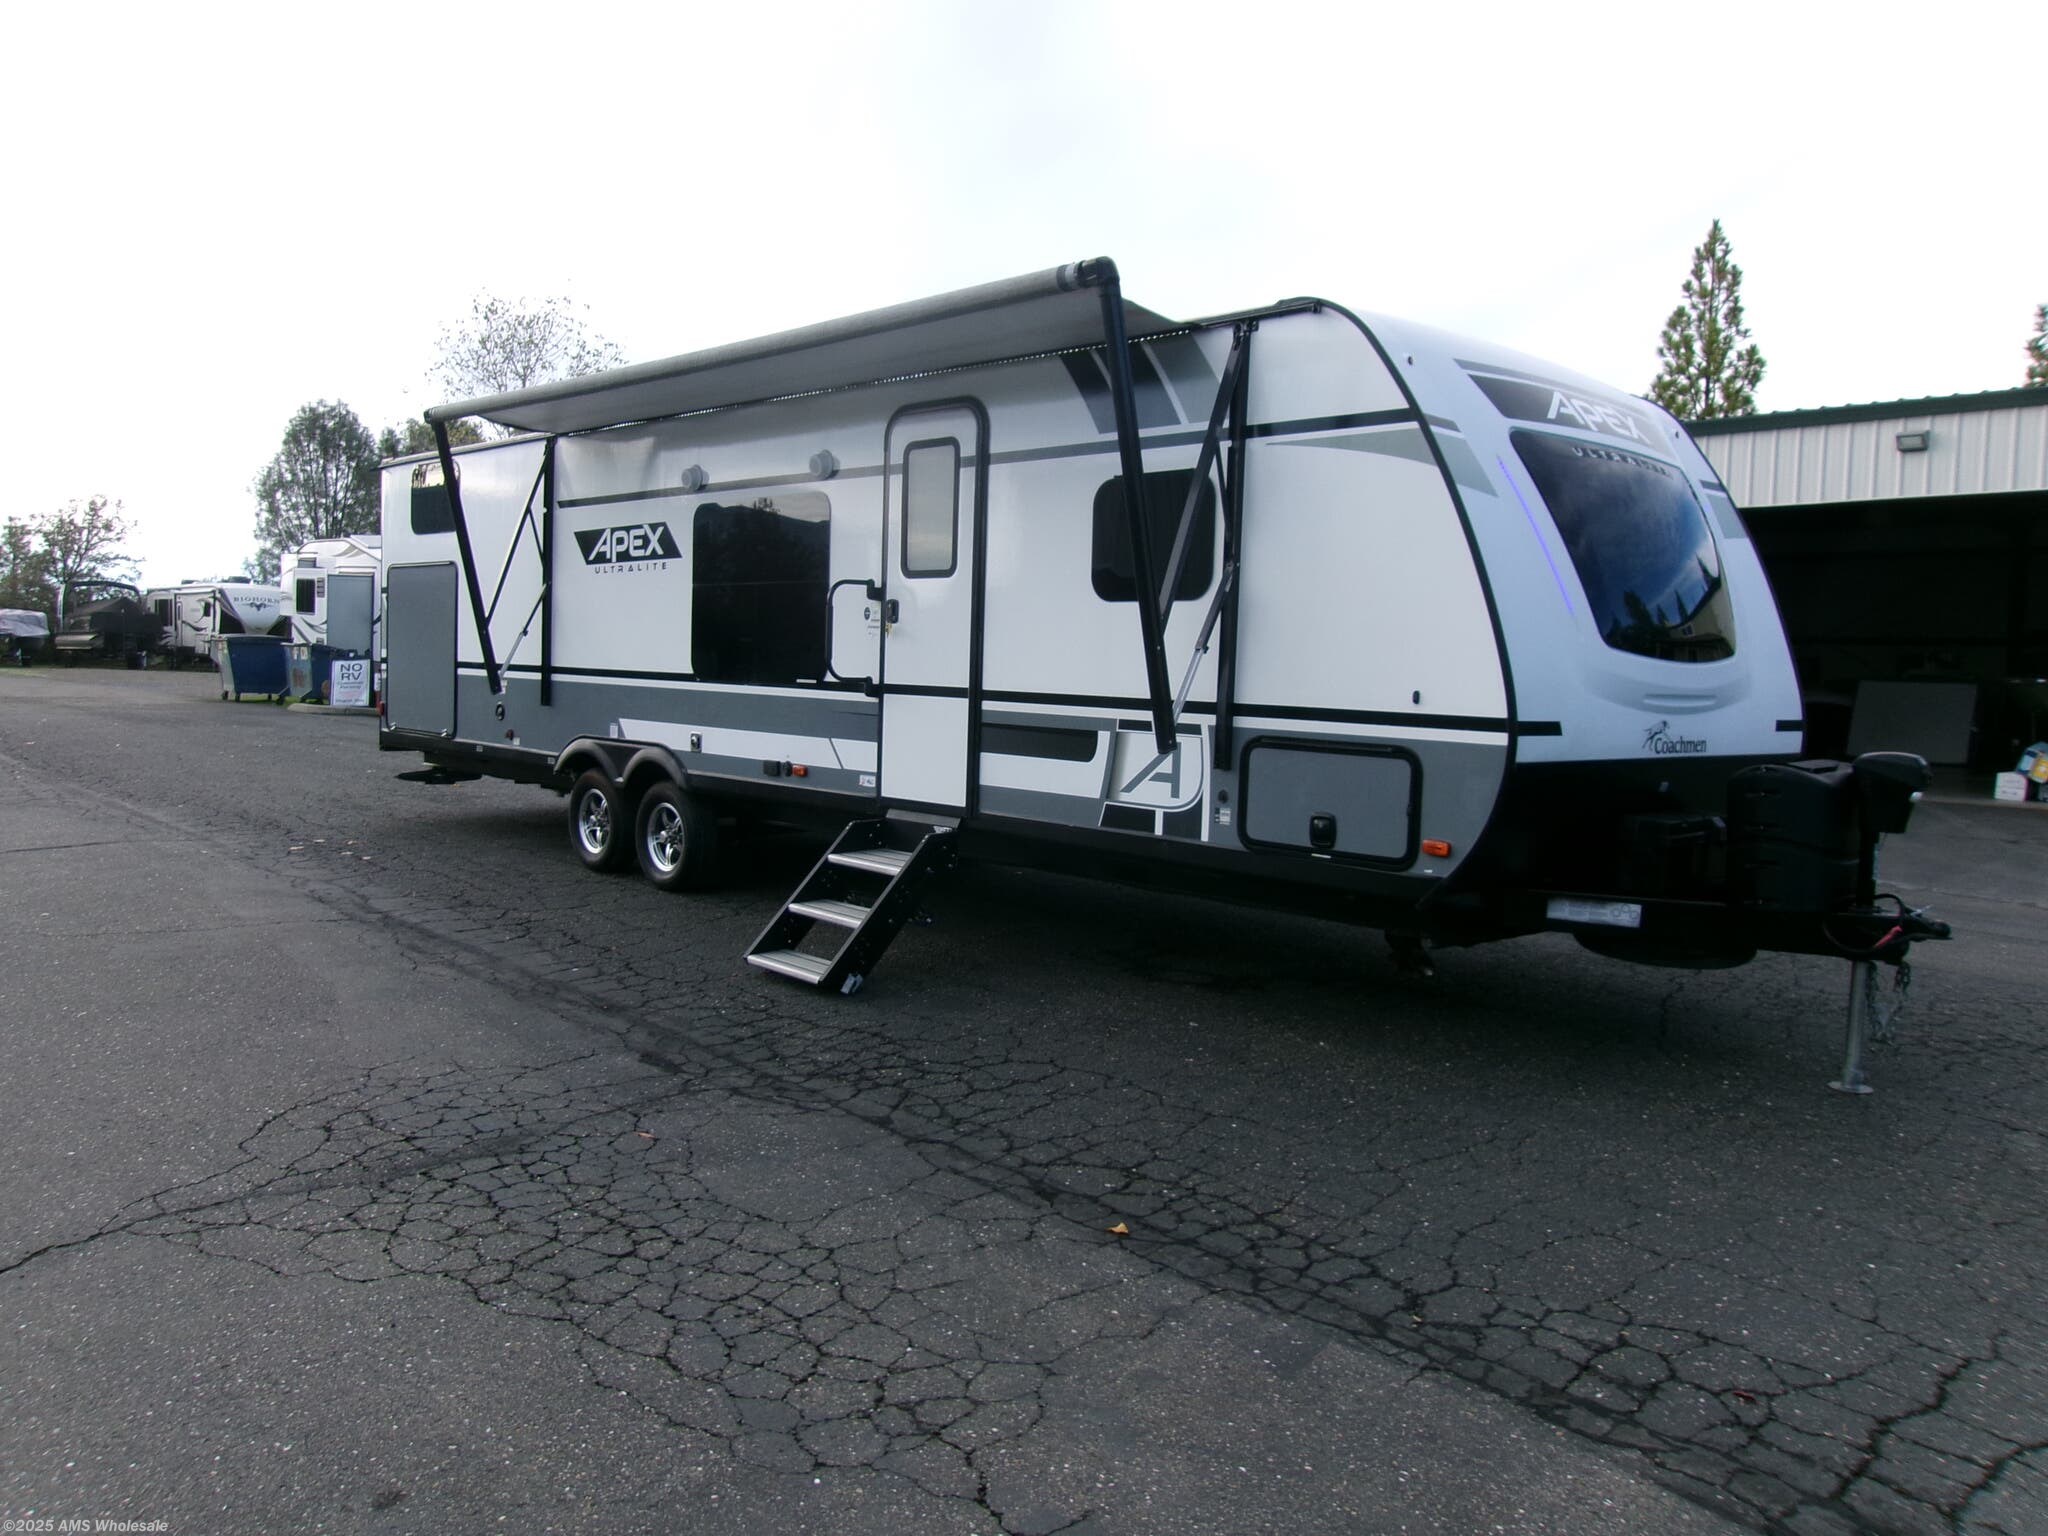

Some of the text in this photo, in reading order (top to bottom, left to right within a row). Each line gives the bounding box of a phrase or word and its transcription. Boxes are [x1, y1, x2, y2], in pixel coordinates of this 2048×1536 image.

[1547, 391, 1651, 445] APEX
[588, 524, 664, 562] APEX
[595, 561, 667, 574] ULTRALITE
[341, 662, 362, 672] NO
[341, 672, 362, 680] RV
[1653, 736, 1707, 754] Coachmen
